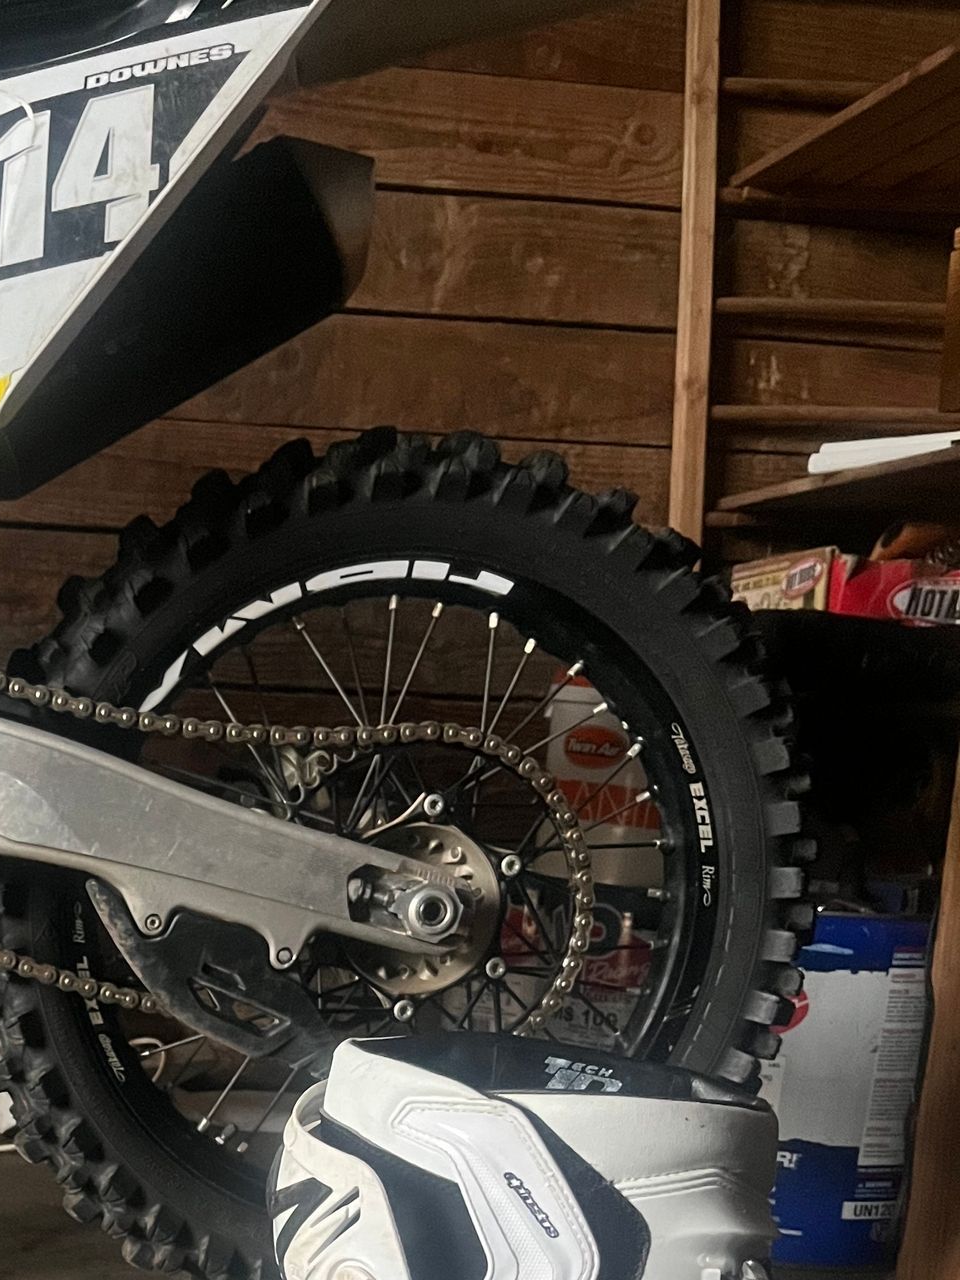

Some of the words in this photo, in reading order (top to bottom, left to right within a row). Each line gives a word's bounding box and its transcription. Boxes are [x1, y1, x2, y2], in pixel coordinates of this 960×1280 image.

[84, 44, 235, 89] DOWNES
[568, 738, 597, 754] Twin
[597, 742, 621, 756] Air
[689, 781, 714, 853] EXCEL
[701, 864, 715, 901] Rim
[76, 955, 104, 1026] EXEL
[544, 1056, 613, 1077] TECH
